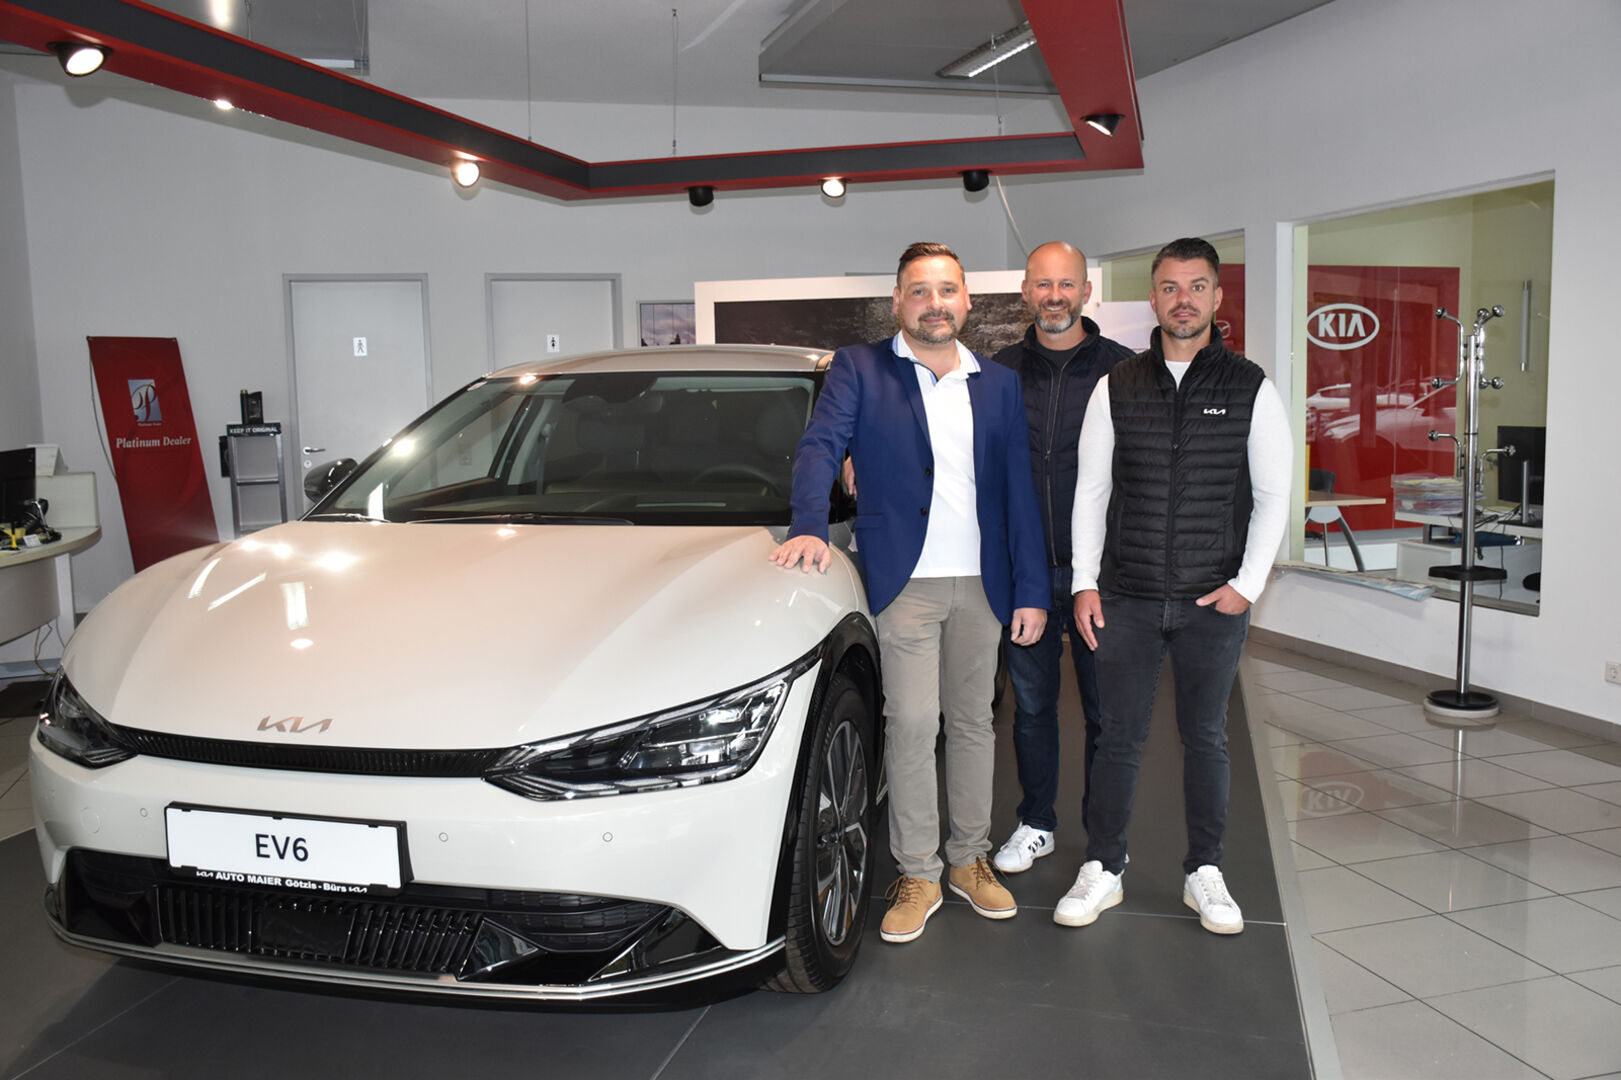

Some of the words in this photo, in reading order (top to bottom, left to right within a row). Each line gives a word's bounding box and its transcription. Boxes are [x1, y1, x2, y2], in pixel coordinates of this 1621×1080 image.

[1318, 313, 1366, 337] KIA
[116, 437, 160, 449] Platinum
[163, 436, 192, 446] Dealer
[257, 715, 334, 733] KIA
[255, 833, 309, 862] EV6
[216, 871, 245, 882] AUTO
[247, 874, 282, 886] MAIER
[285, 879, 317, 889] Götzis
[323, 882, 347, 892] Bürs
